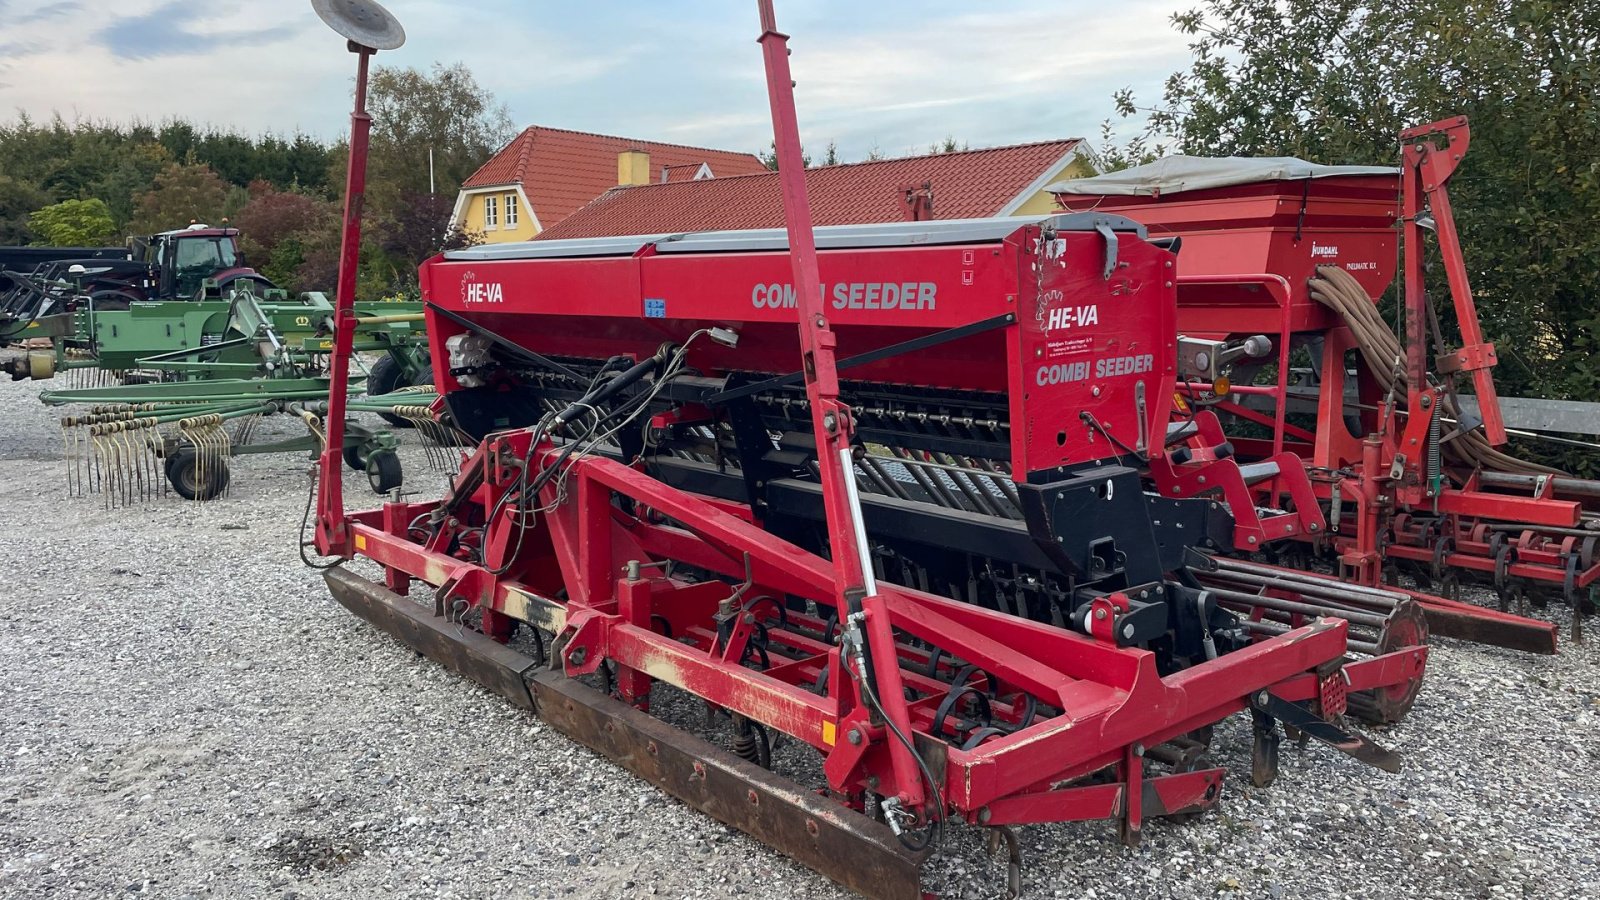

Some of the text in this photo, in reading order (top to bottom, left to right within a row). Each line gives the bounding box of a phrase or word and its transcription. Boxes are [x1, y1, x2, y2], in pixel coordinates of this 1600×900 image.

[467, 283, 503, 302] HE-VA
[832, 281, 938, 310] SEEDER
[1048, 304, 1098, 331] HE-VA
[1036, 353, 1154, 387] COMBI SEEDER
